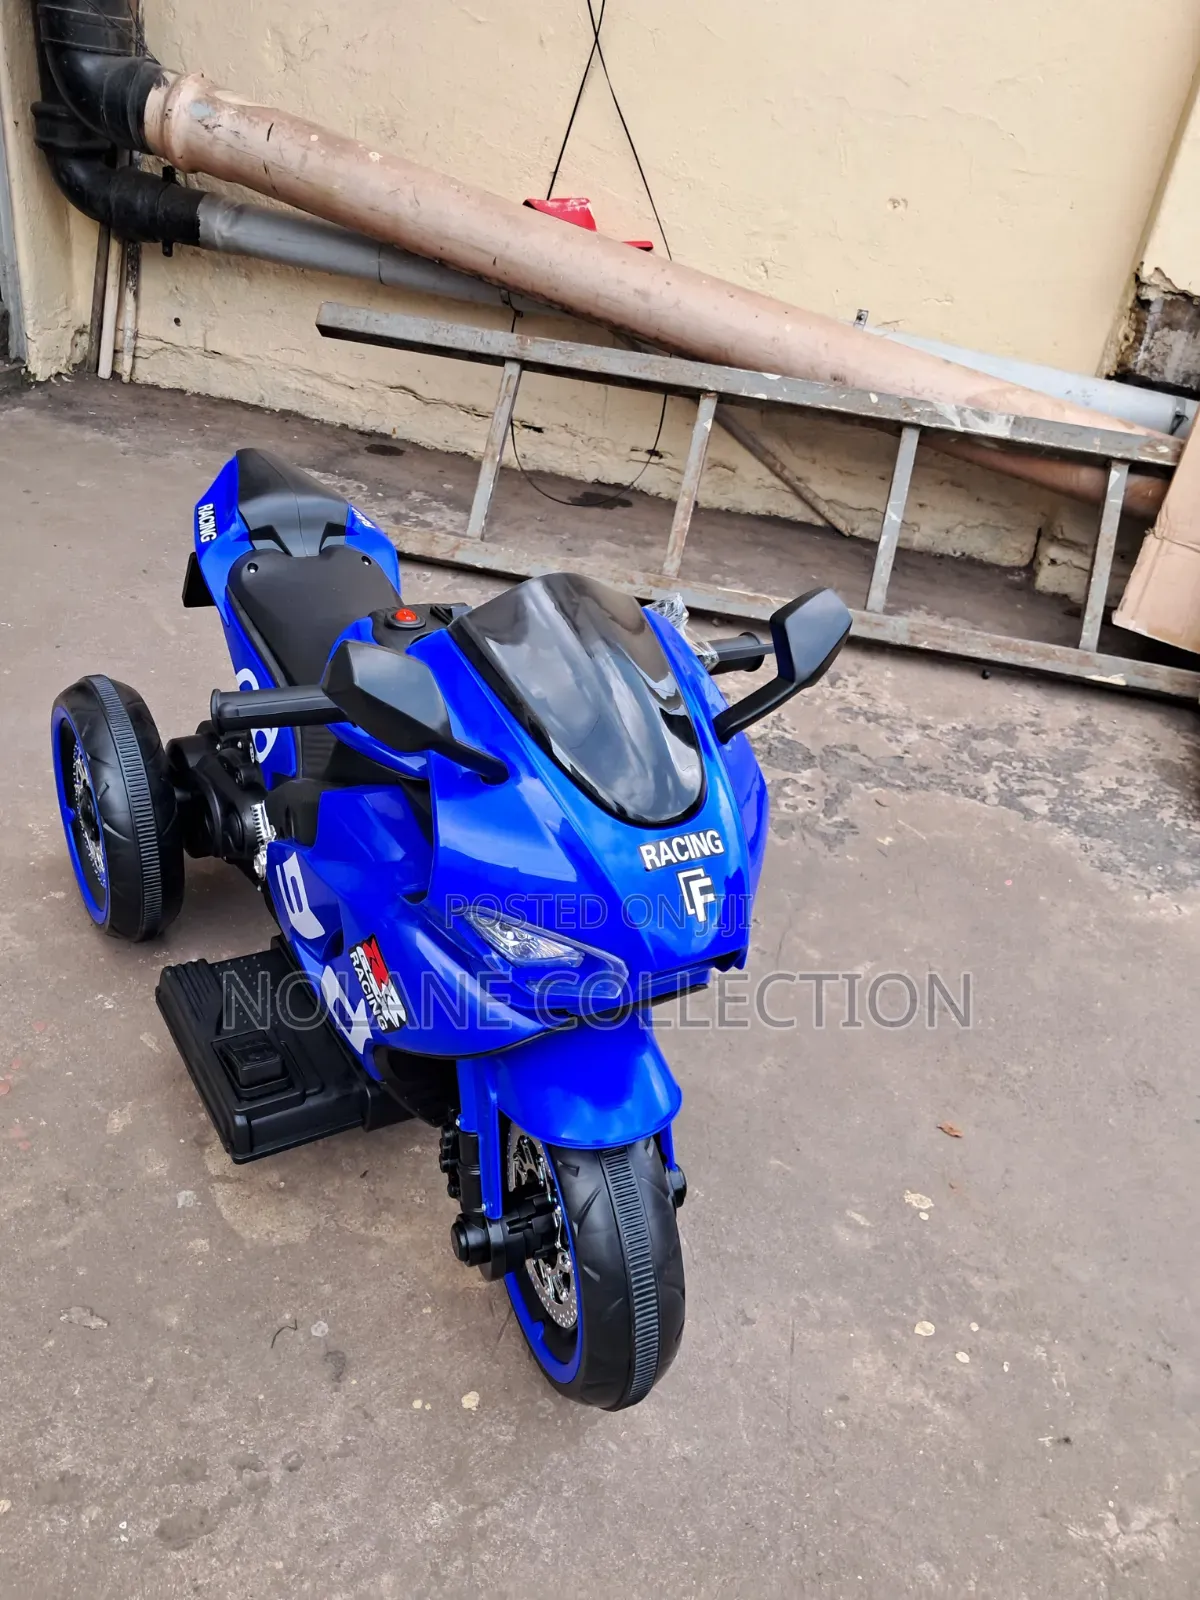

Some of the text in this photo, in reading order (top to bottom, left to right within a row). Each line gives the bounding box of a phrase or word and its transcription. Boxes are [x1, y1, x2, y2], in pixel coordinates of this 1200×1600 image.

[198, 503, 217, 543] RACING
[640, 830, 724, 870] RACING
[350, 951, 388, 1031] RACING
